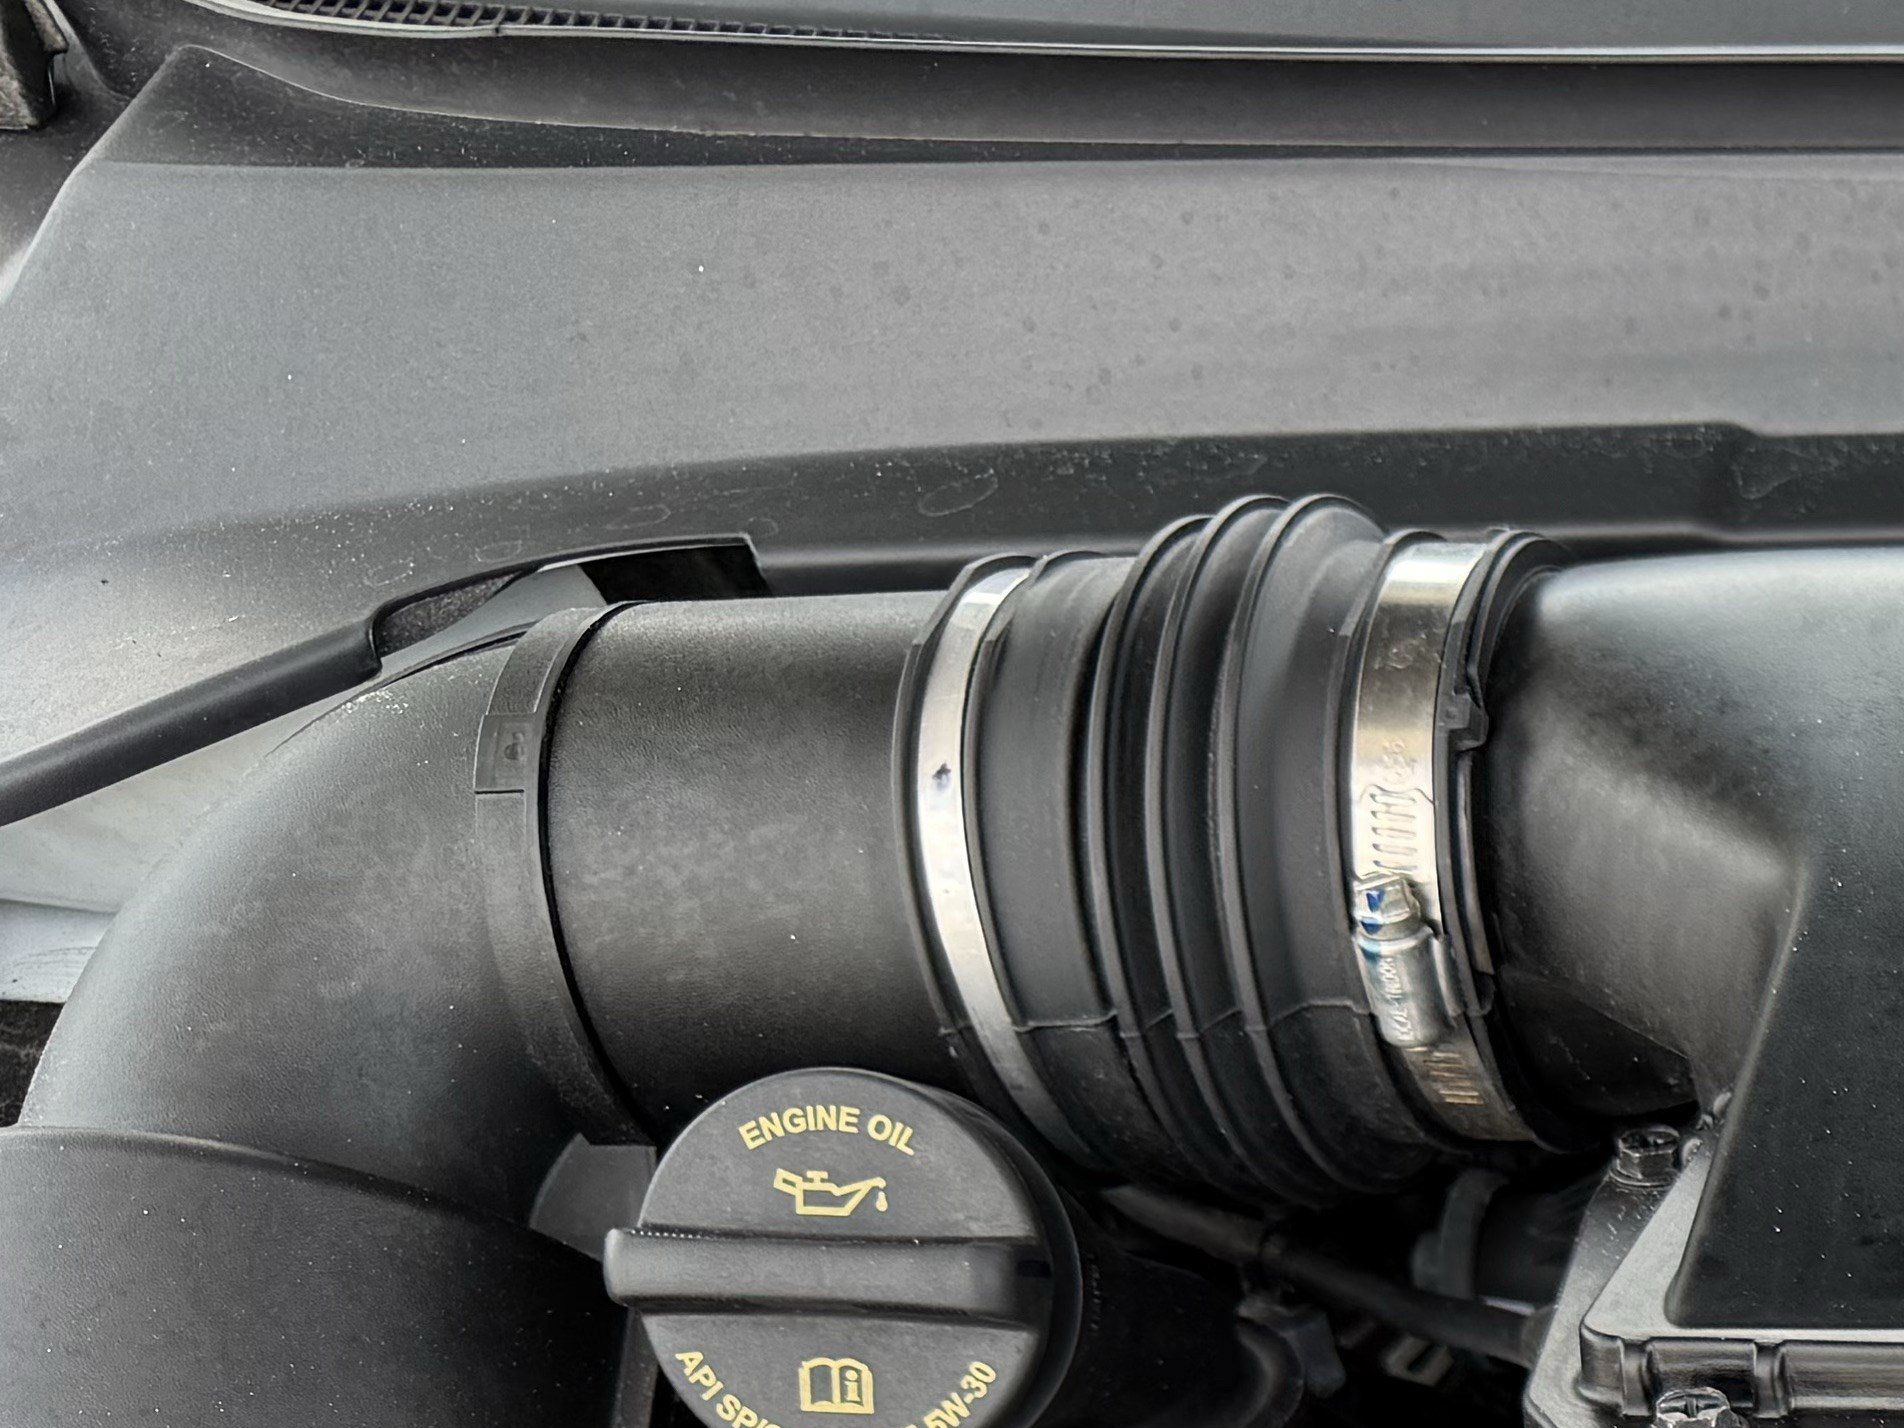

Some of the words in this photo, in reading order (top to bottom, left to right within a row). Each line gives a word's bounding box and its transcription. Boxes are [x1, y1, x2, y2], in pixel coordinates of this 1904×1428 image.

[738, 1105, 861, 1151] ENGINE
[867, 1113, 916, 1156] OIL
[675, 1350, 723, 1400] API
